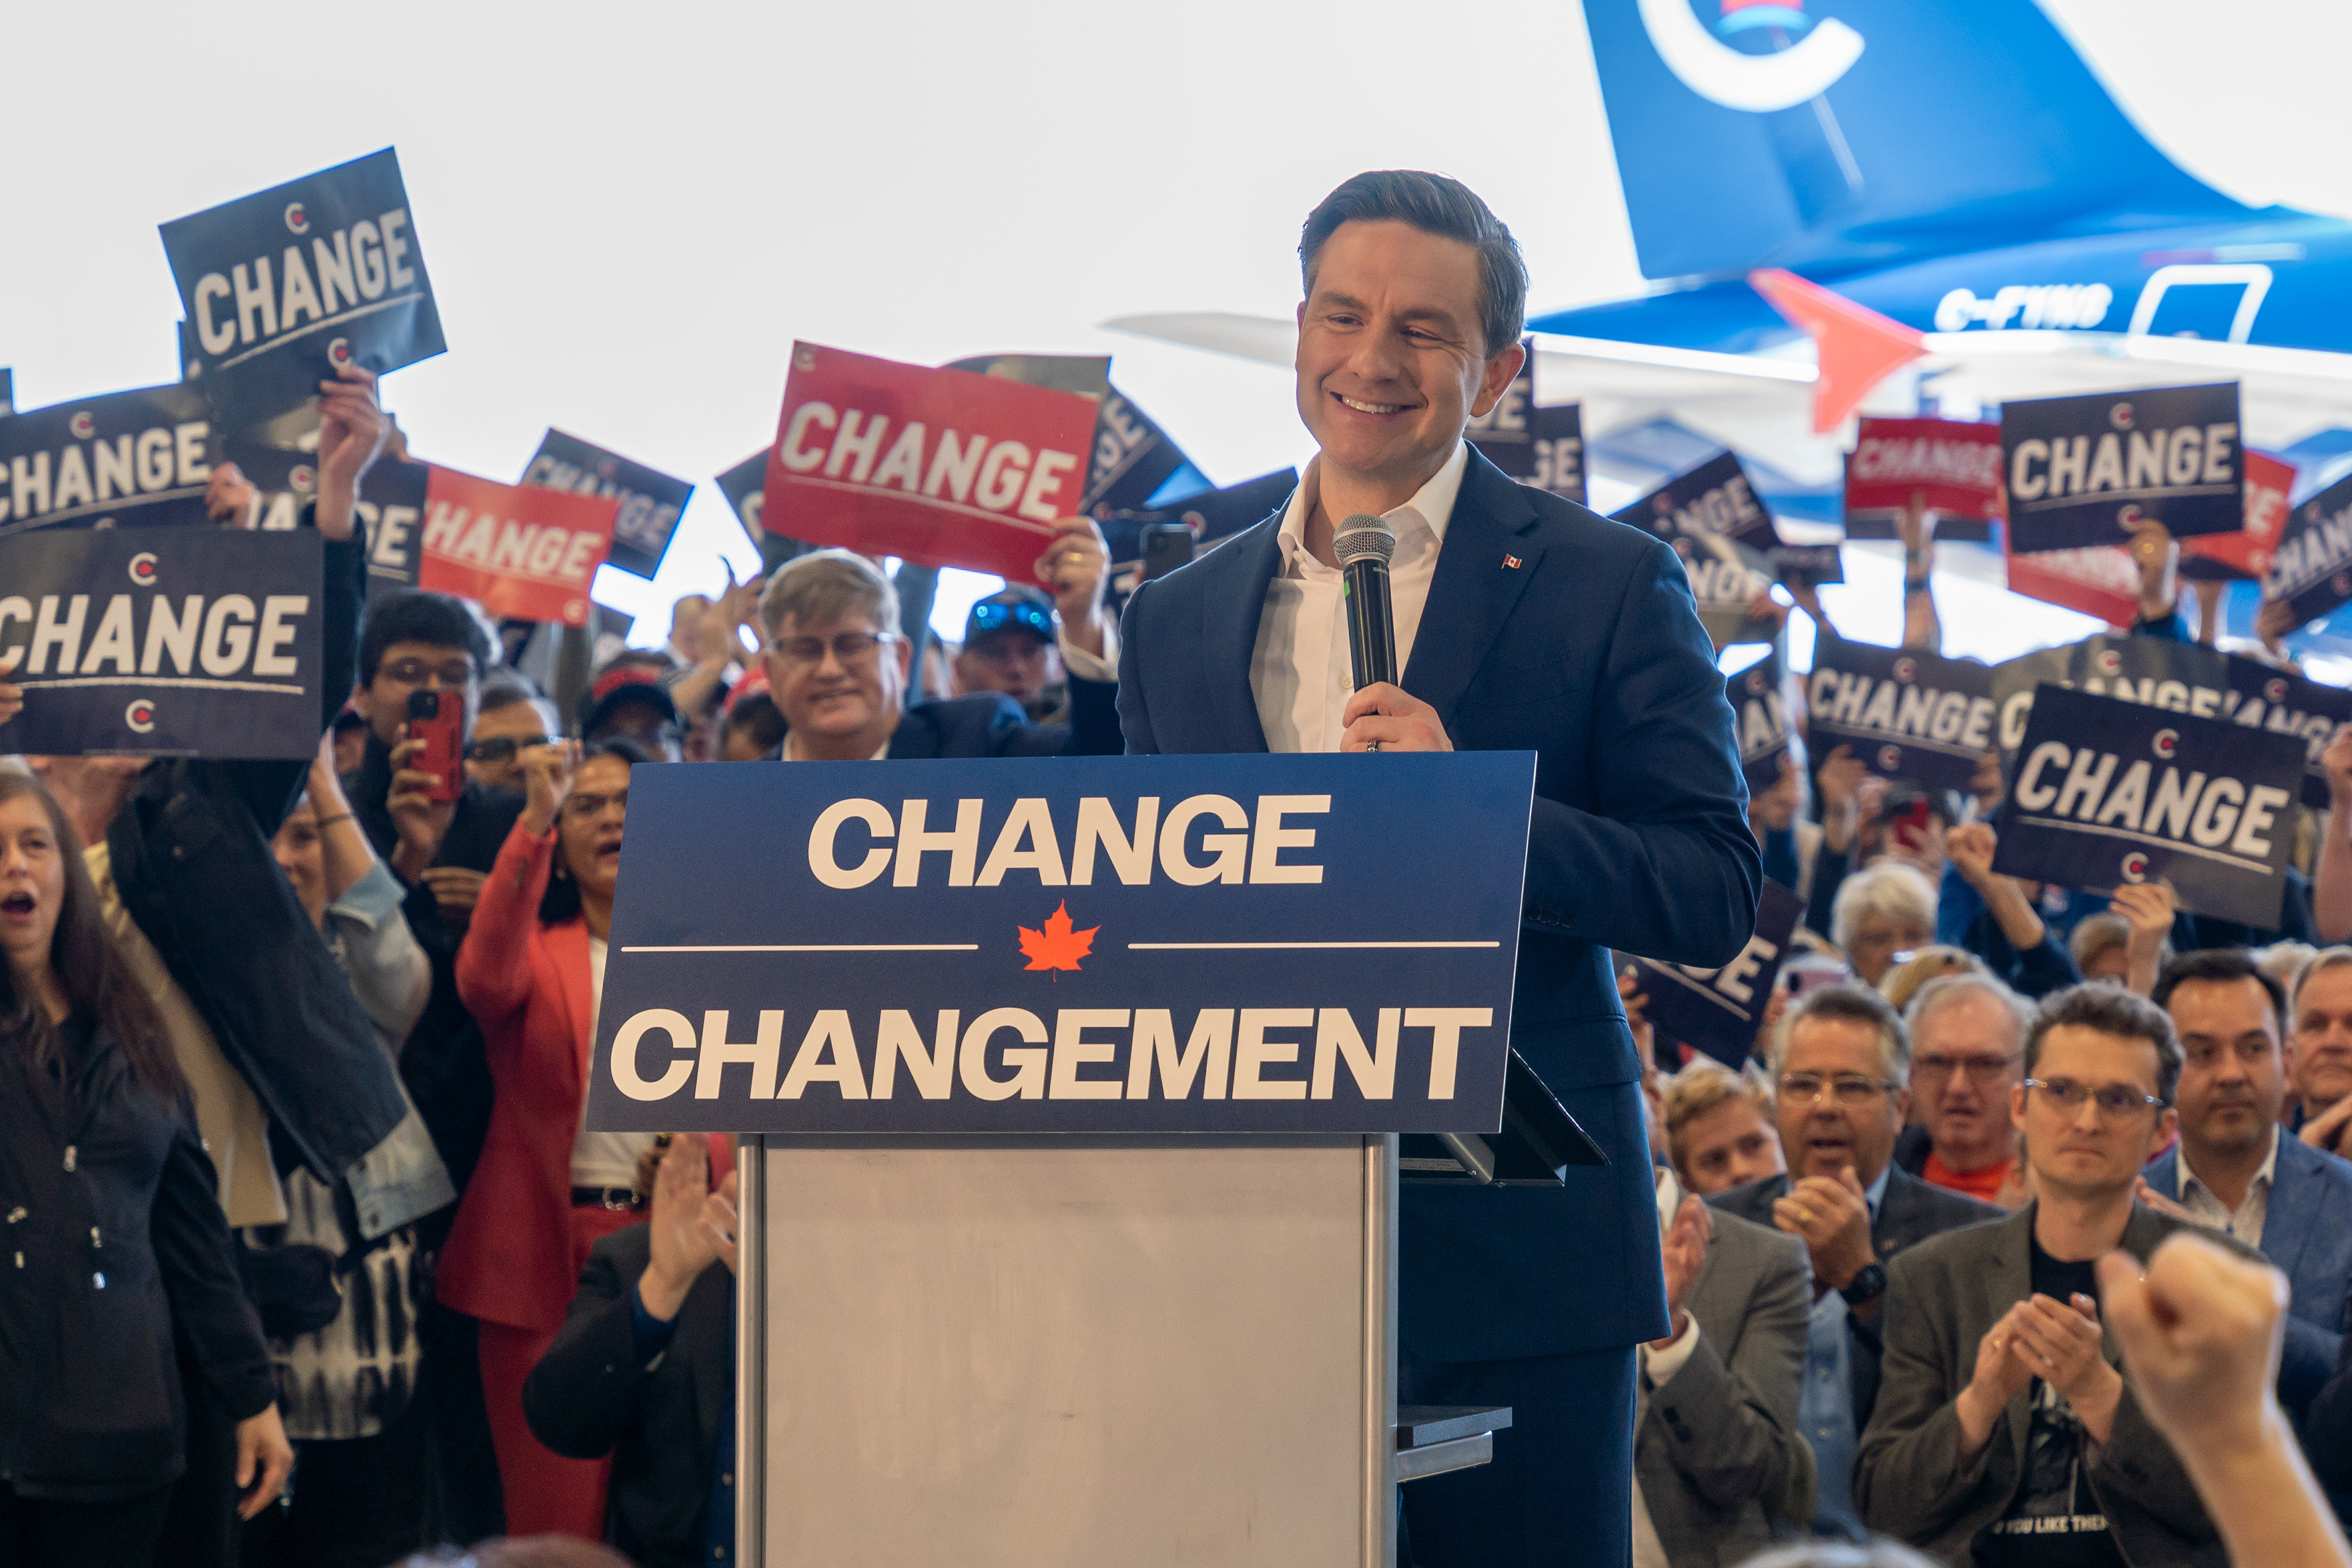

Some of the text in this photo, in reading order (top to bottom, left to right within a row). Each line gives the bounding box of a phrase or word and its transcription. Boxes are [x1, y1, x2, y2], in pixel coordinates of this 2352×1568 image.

[194, 208, 415, 355] CHANGE
[780, 401, 1077, 521] CHANGE
[2011, 423, 2237, 501] CHANGE
[423, 500, 604, 578] HANGE
[1810, 668, 1996, 748] CHANGE
[808, 794, 1332, 889] CHANGE
[2016, 741, 2291, 858] CHANGE
[610, 1007, 1493, 1101] CHANGEMENT
[2006, 1517, 2033, 1534] YOU
[2034, 1515, 2069, 1533] LIKE
